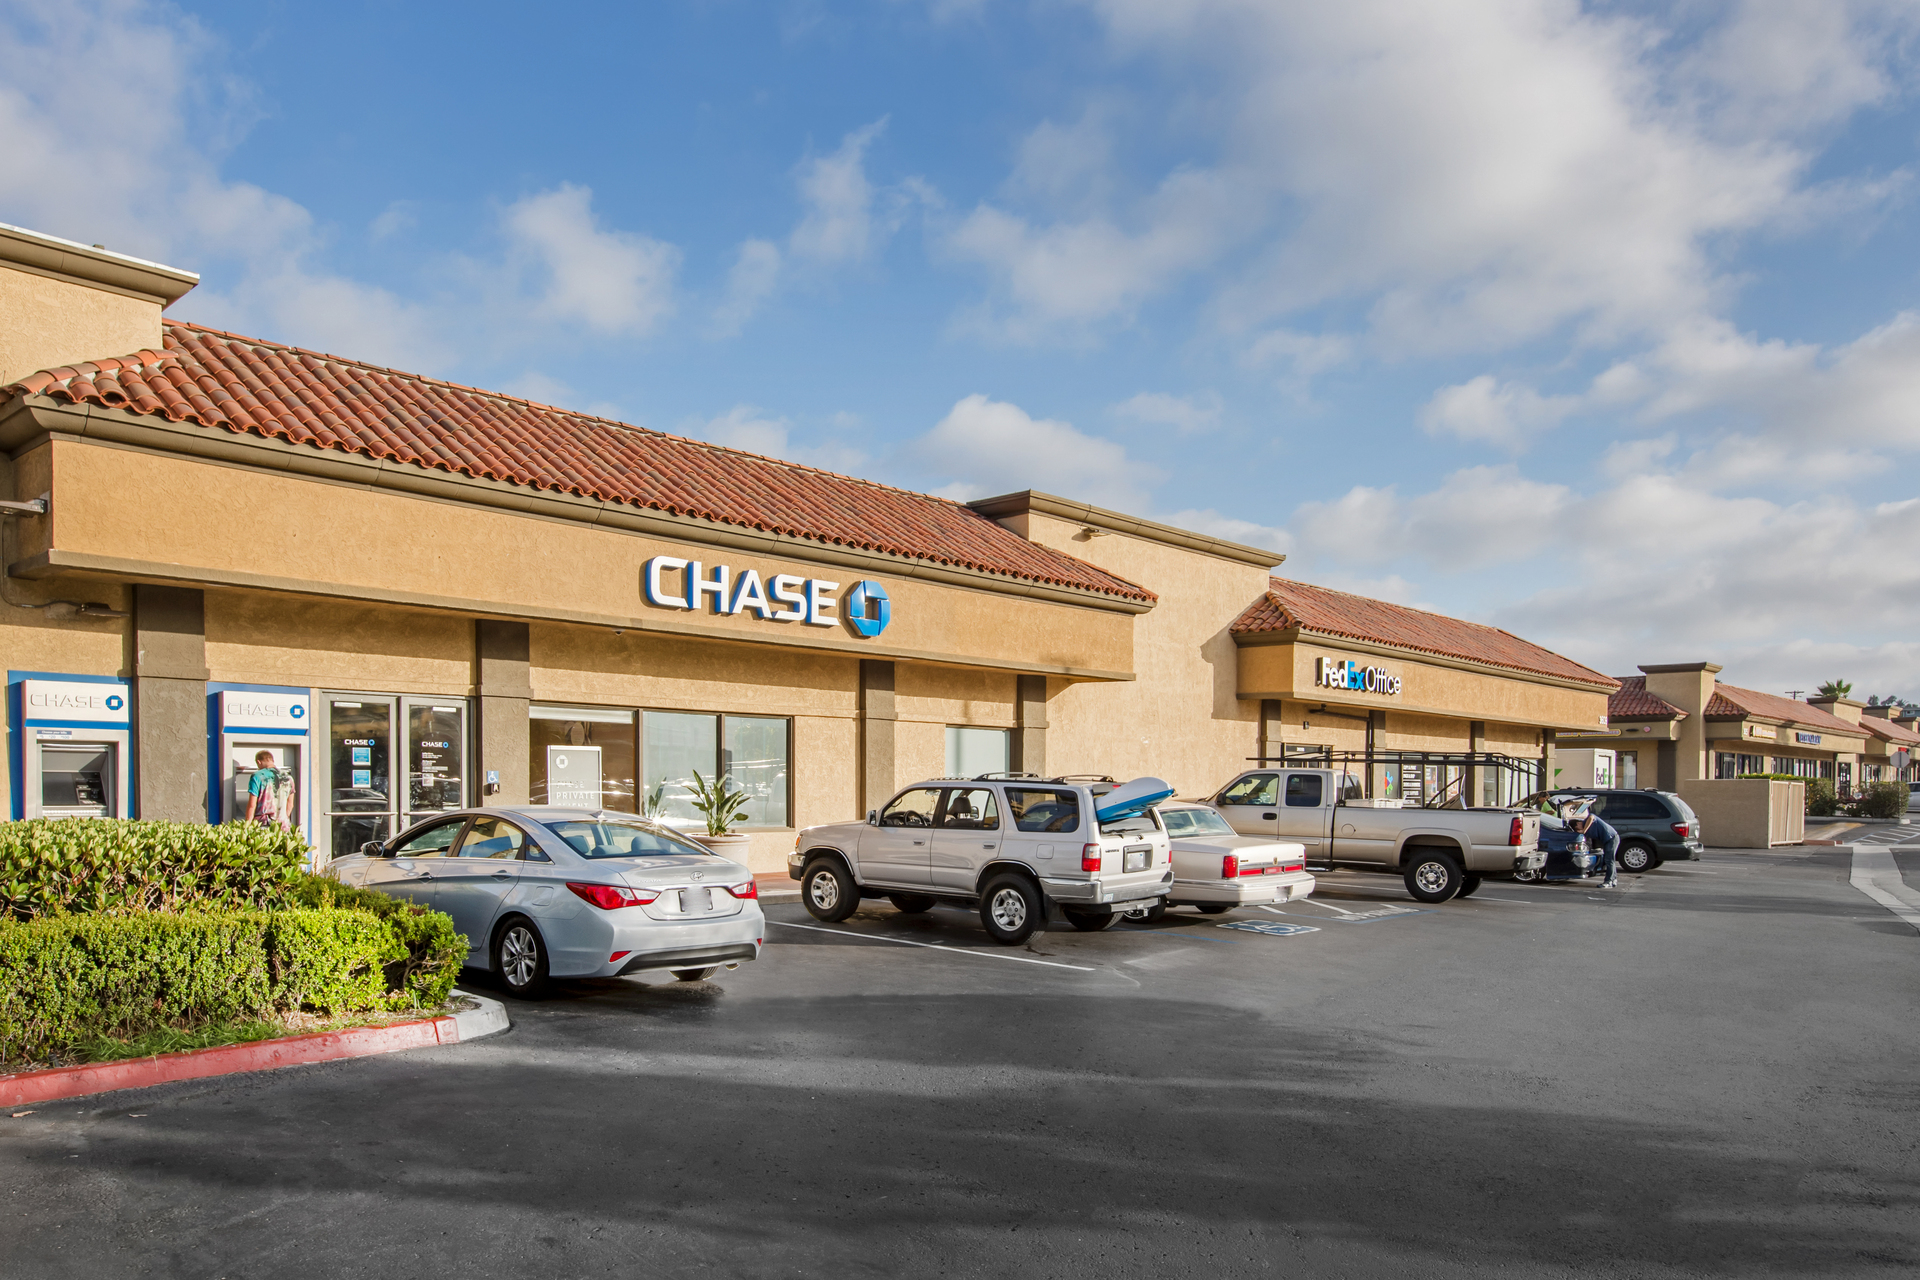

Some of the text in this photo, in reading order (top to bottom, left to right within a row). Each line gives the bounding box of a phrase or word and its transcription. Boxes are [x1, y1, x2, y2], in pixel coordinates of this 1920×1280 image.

[645, 555, 840, 626] CHASE
[1321, 656, 1401, 695] FedEx Office
[30, 693, 103, 709] CHASE
[227, 702, 288, 718] CHASE
[556, 791, 595, 800] PRIVATE
